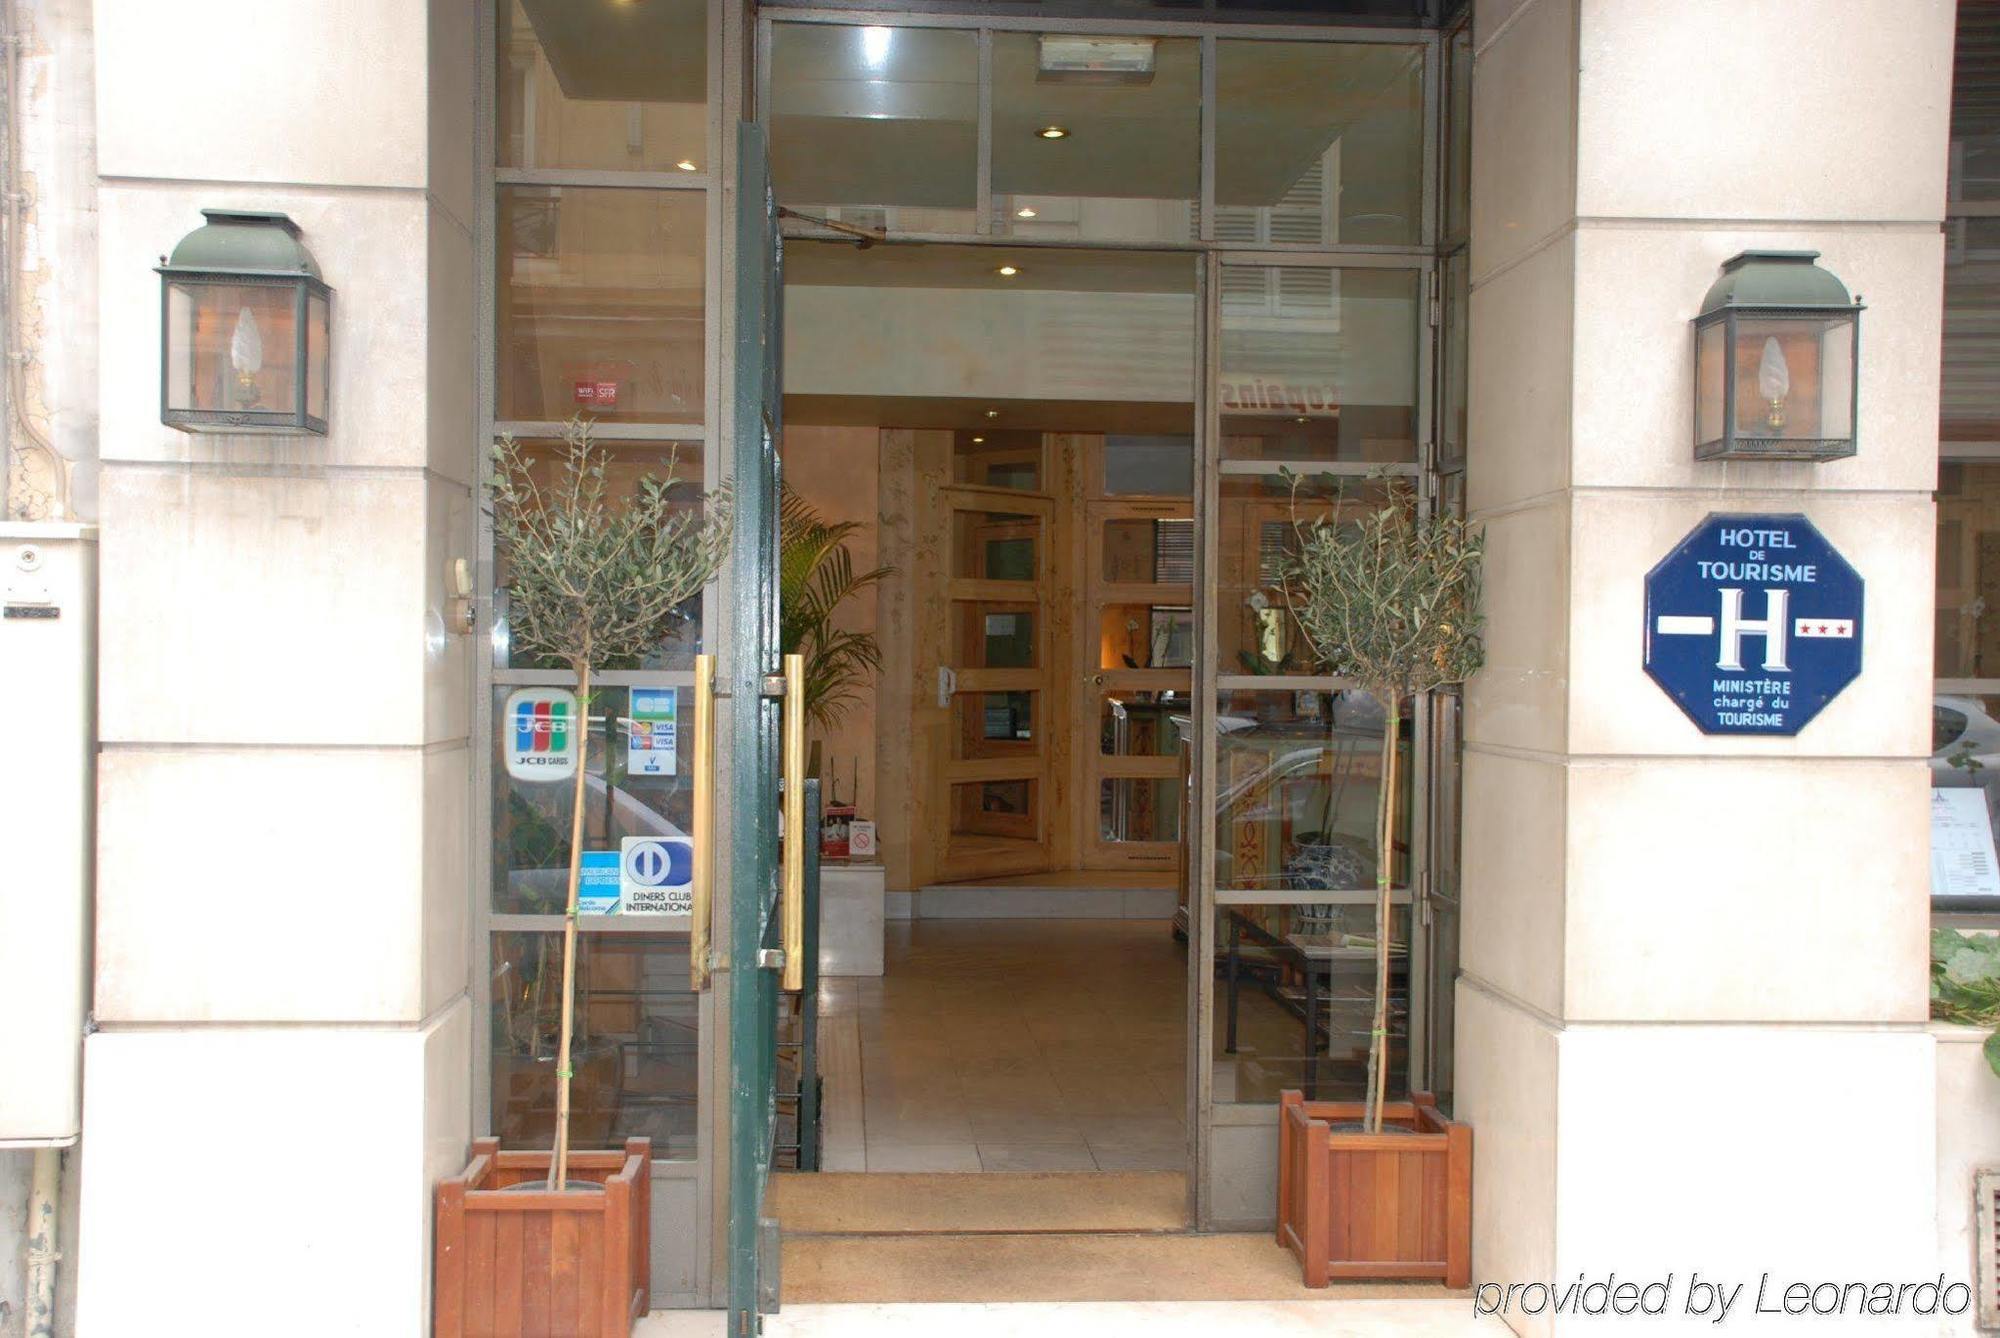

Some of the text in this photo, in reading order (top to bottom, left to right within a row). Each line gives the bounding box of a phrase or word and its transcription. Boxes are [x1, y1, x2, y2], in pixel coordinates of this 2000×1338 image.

[599, 388, 615, 398] SFR
[1719, 529, 1797, 549] HOTEL
[1749, 550, 1765, 560] DE
[1697, 561, 1816, 582] TOURISME
[1715, 588, 1791, 672] H
[1713, 678, 1791, 695] MINISTÈRE
[1713, 696, 1789, 711] chargé du
[518, 717, 567, 733] JCB
[656, 723, 674, 731] VISA
[1717, 712, 1783, 727] TOURISME
[516, 757, 569, 765] JCB CARDS
[633, 892, 692, 901] DINERS CLUB
[626, 902, 693, 911] INTERNATIONA
